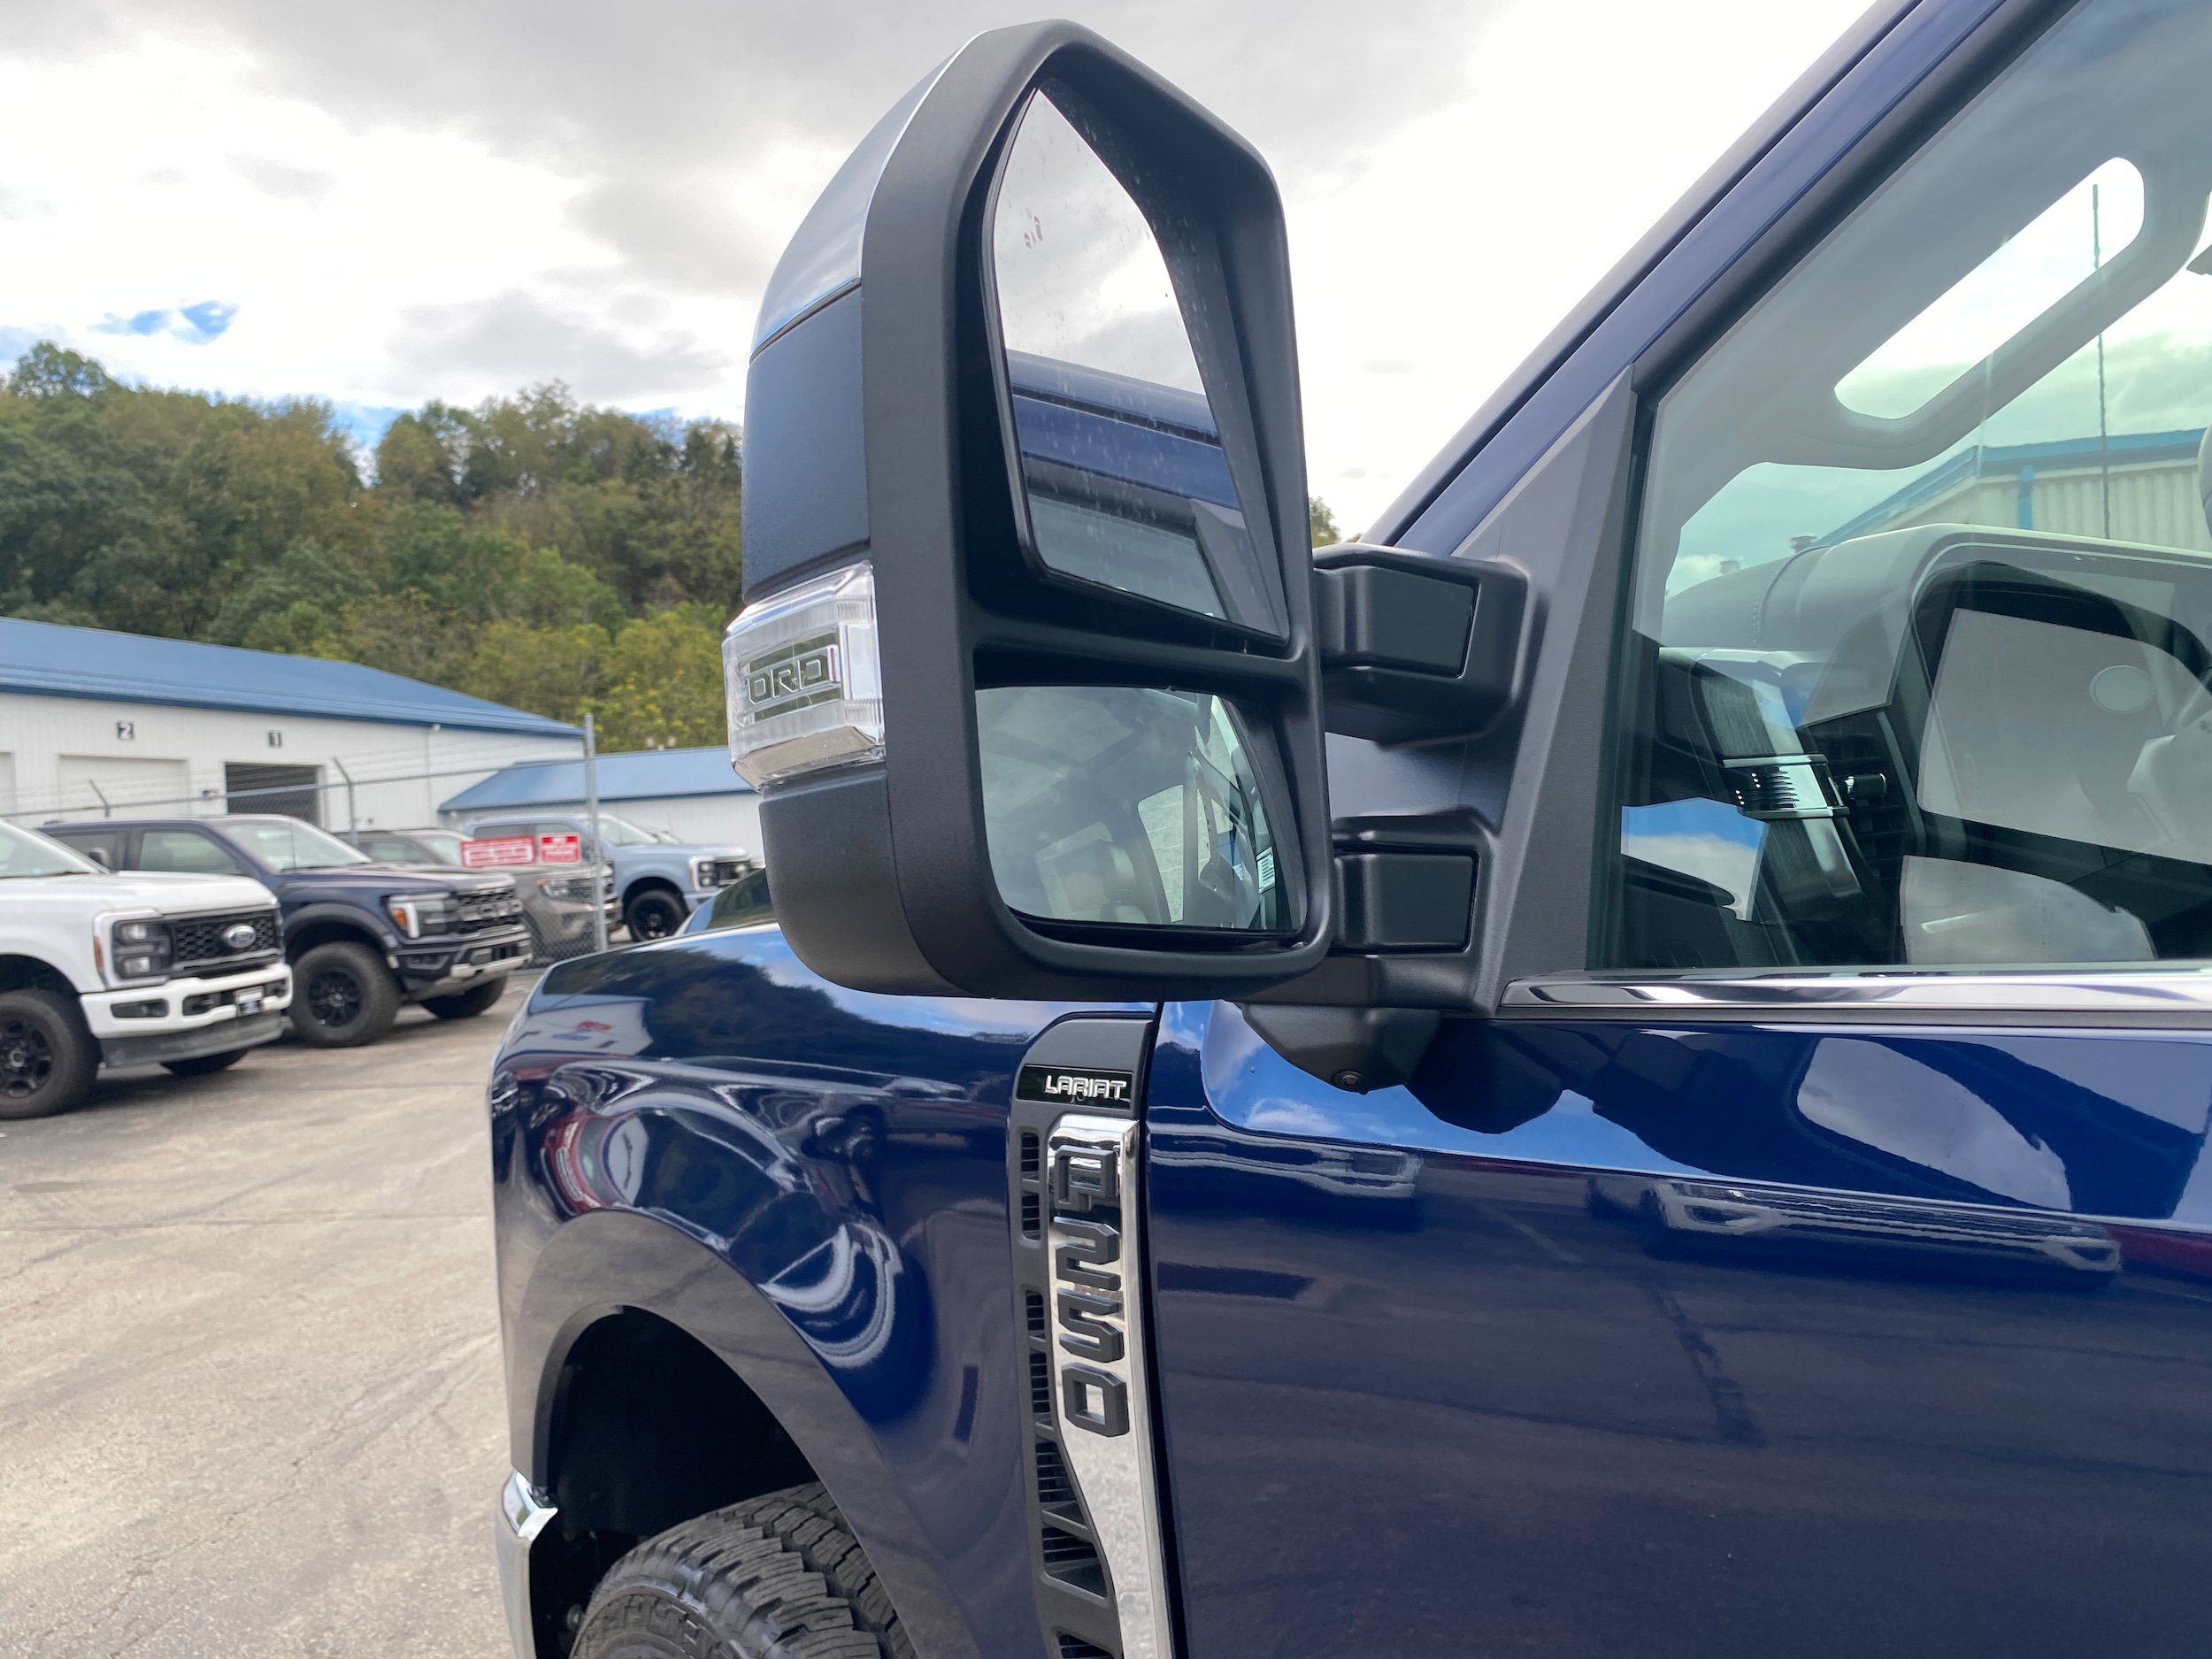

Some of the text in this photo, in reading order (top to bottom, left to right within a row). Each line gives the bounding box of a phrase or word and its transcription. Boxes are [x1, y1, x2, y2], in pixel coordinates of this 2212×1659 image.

[118, 721, 134, 740] 2
[1044, 1074, 1128, 1100] LARIAT
[1053, 1144, 1131, 1439] F250
